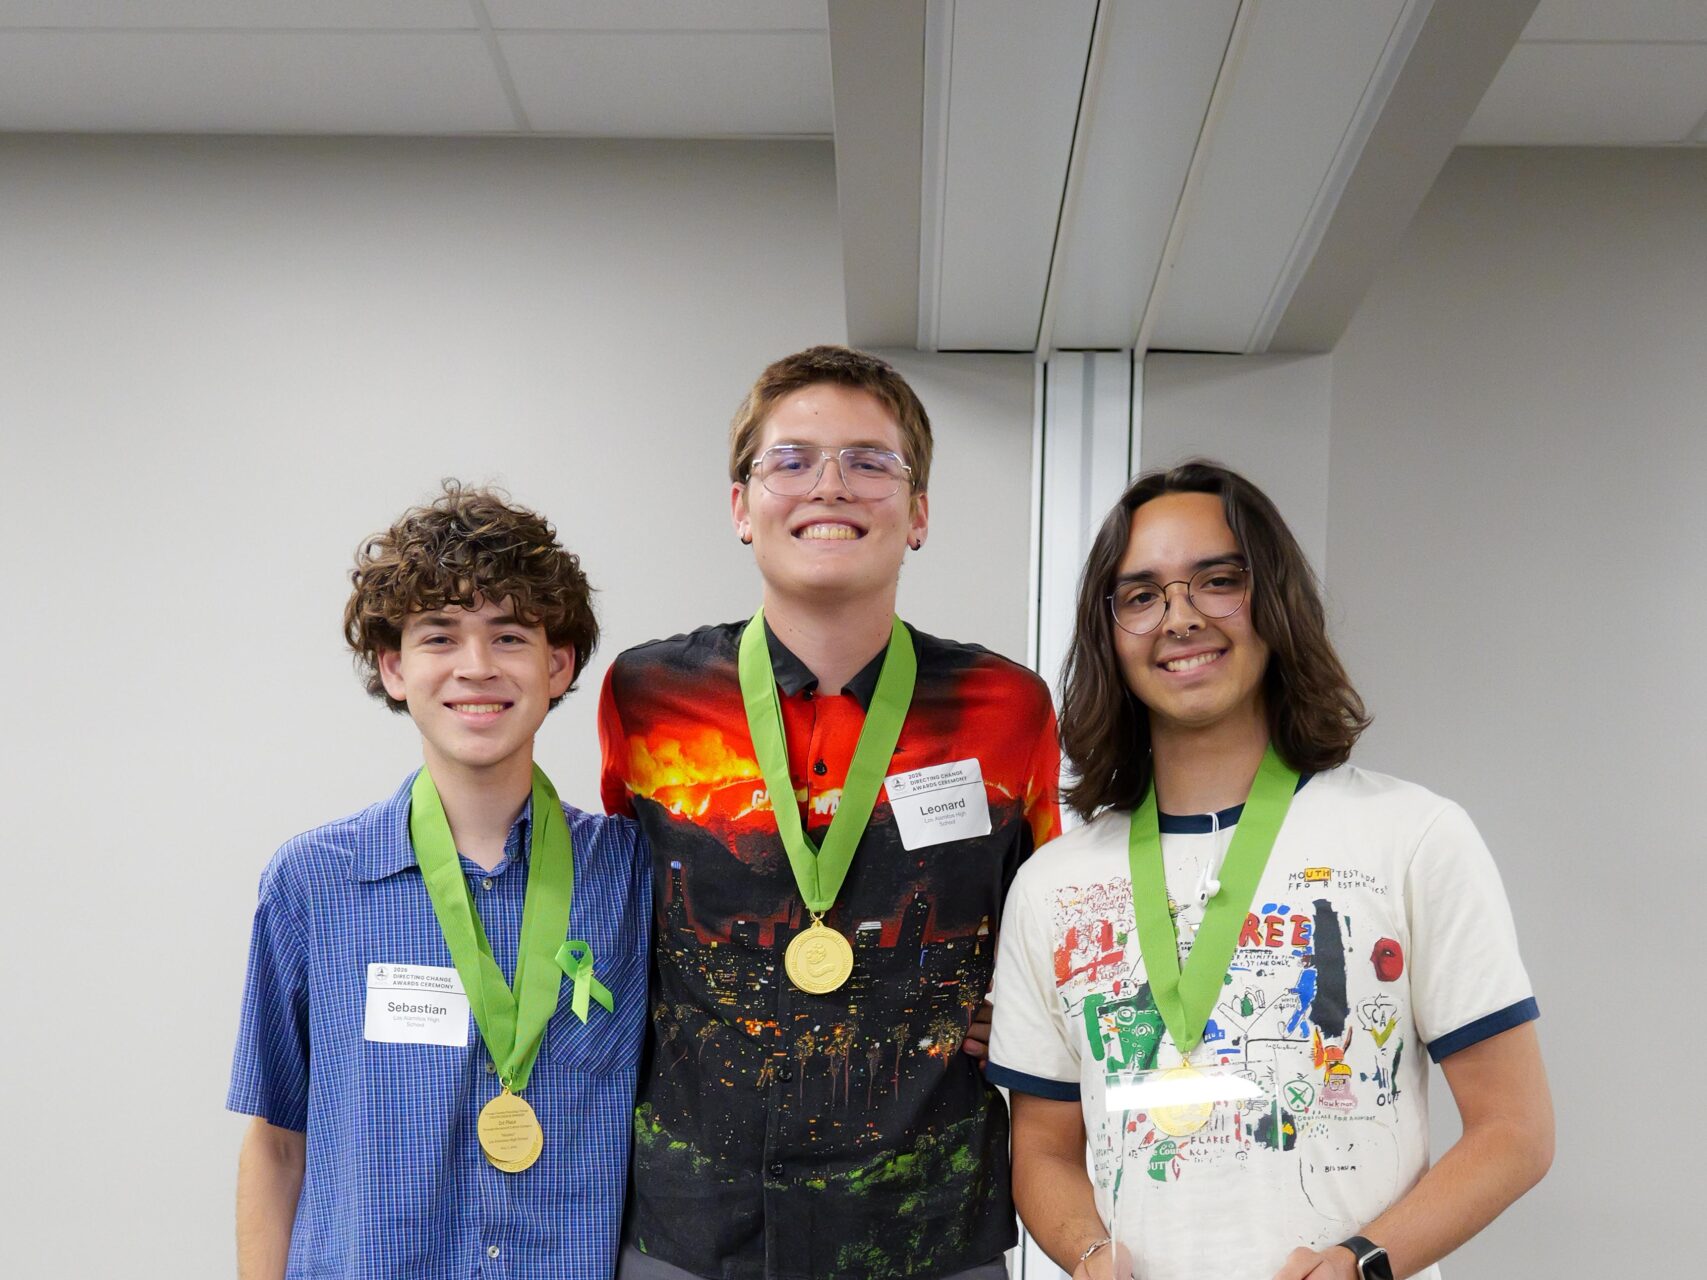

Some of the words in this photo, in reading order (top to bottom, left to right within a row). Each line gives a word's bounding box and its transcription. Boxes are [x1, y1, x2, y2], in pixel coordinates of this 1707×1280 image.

[910, 775, 940, 785] DIRECTING
[940, 770, 963, 779] CHANGE
[912, 782, 937, 792] AWARDS
[937, 776, 967, 786] CEREMONY
[920, 798, 966, 816] Leonard
[1288, 869, 1330, 881] MOUTH
[420, 982, 454, 990] CEREMONY
[425, 975, 452, 983] CHANGE
[387, 1001, 447, 1015] Sebastian
